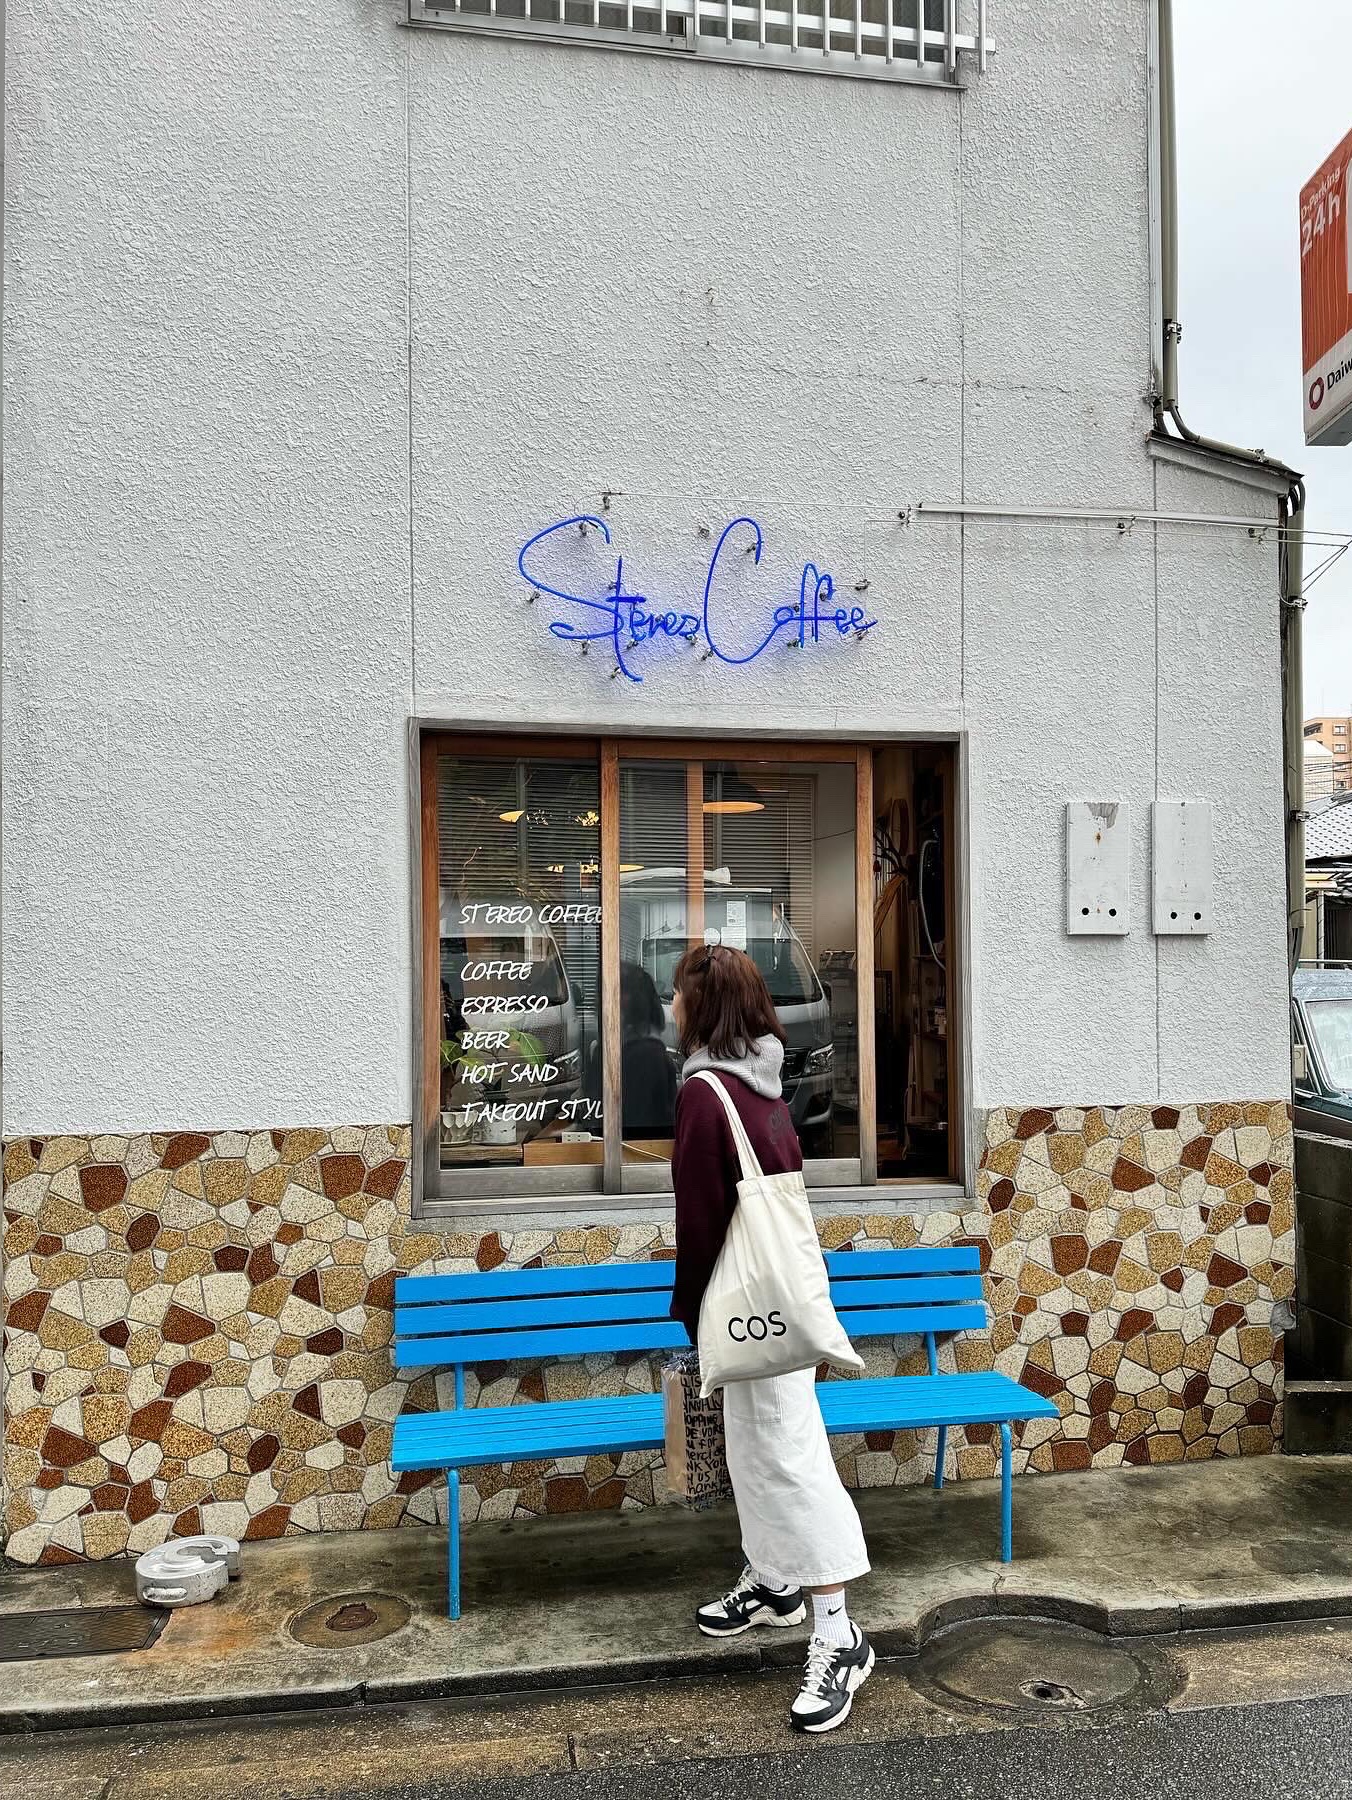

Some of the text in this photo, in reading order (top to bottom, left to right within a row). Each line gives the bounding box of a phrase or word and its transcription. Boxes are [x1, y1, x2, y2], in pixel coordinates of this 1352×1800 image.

[1301, 191, 1340, 257] 24h
[518, 516, 878, 682] Stereo Coffee
[458, 903, 534, 925] STEREO
[460, 961, 534, 982] COFFEE
[461, 995, 549, 1017] ESPRESSO
[461, 1031, 511, 1051] BEER
[461, 1062, 559, 1085] HOT SAND
[461, 1099, 559, 1124] TAKEOUT
[728, 1310, 787, 1342] COS
